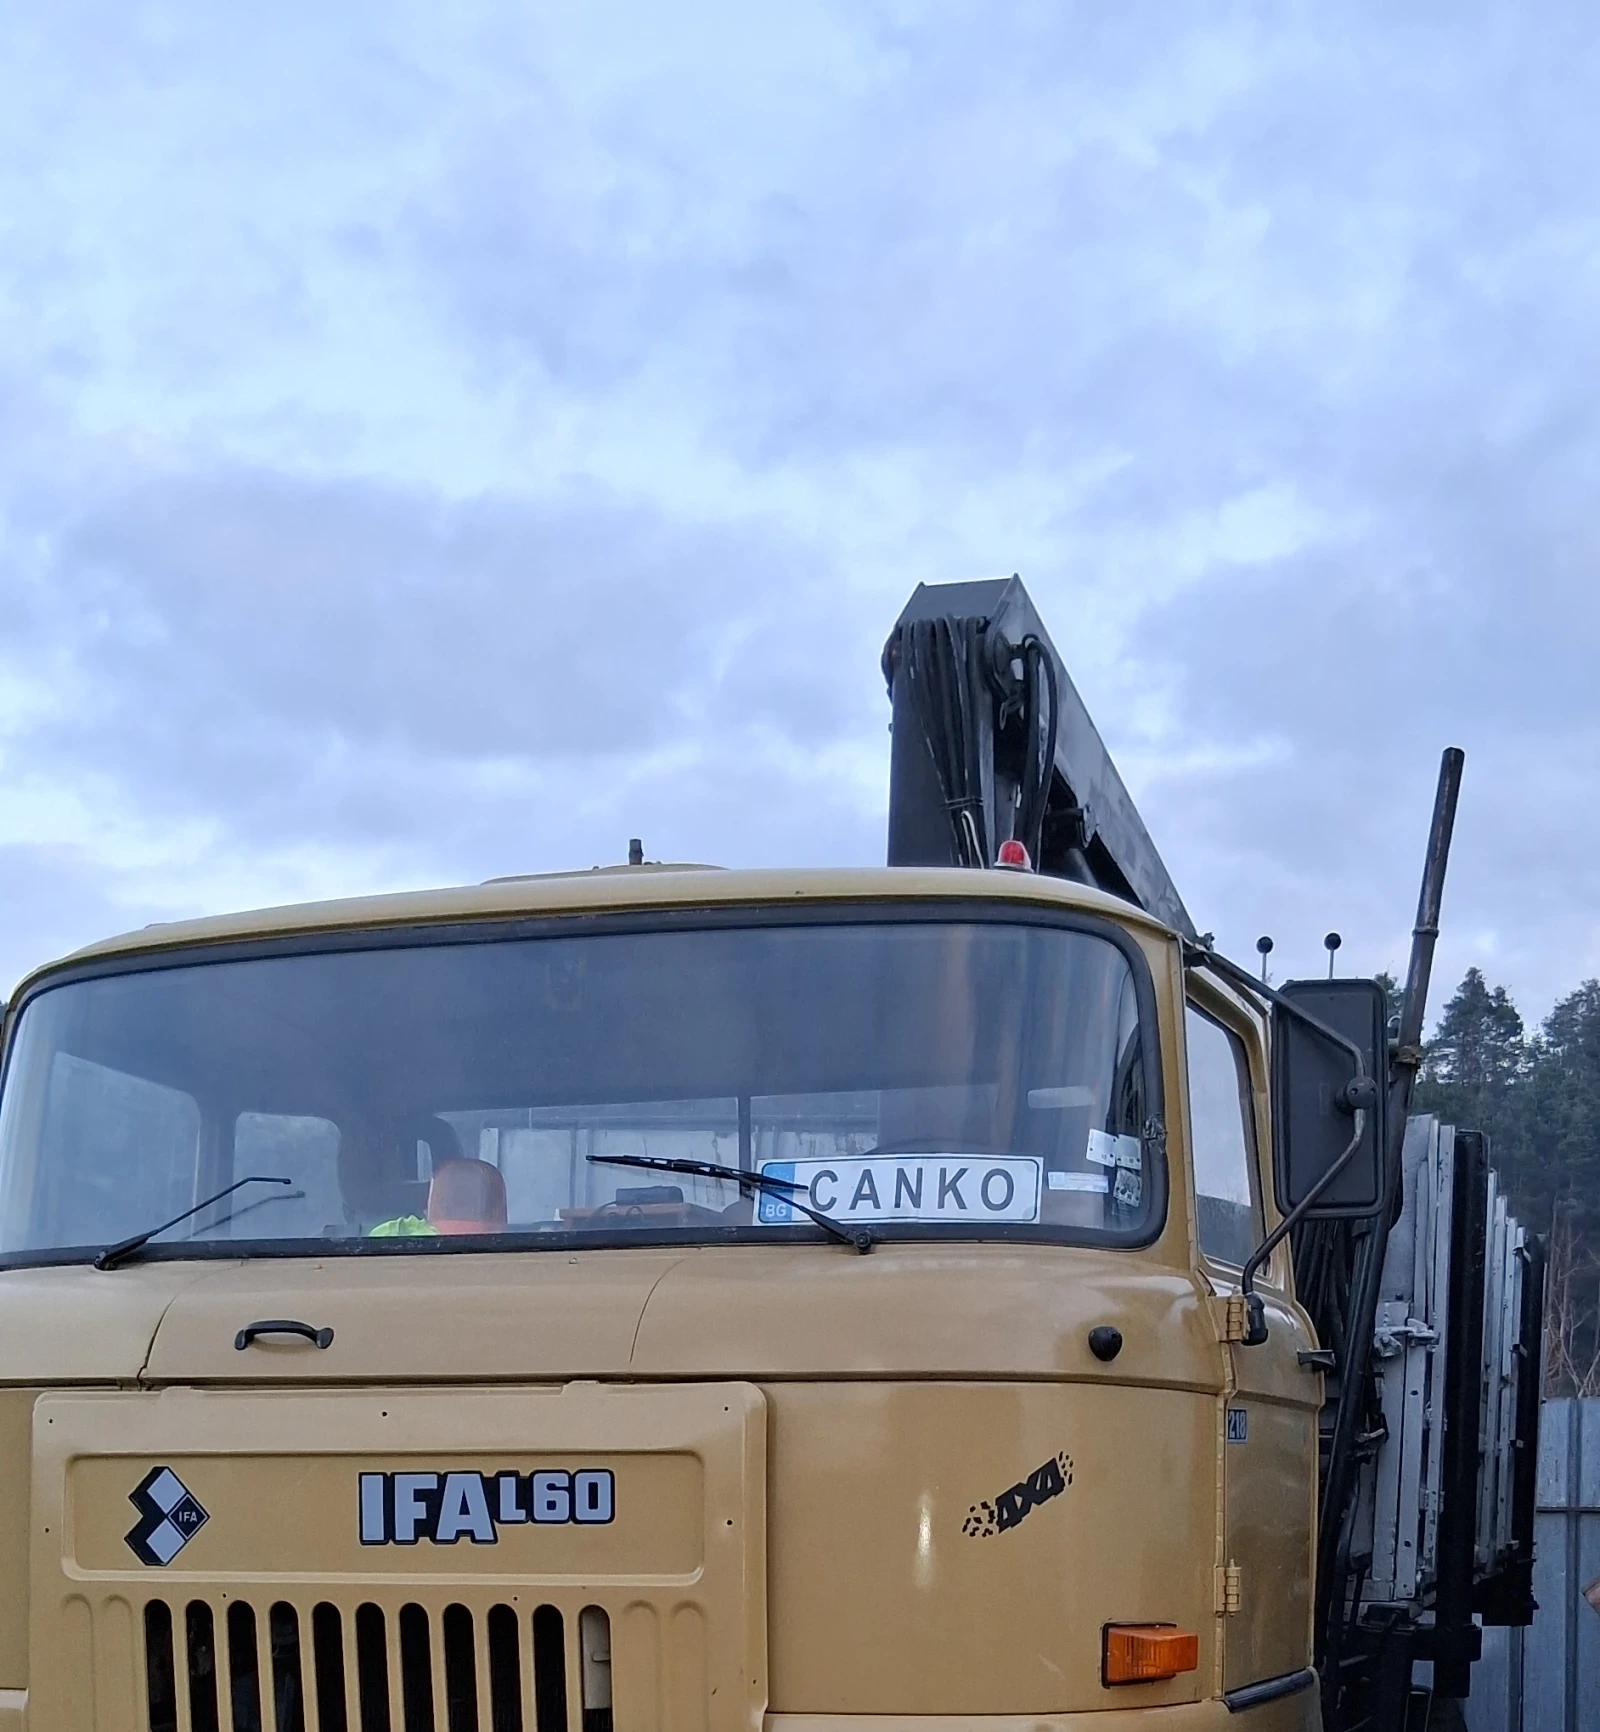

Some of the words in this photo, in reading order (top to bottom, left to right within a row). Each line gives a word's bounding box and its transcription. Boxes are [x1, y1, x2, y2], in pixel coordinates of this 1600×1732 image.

[809, 1166, 1015, 1212] CANKO
[765, 1202, 787, 1218] BG
[178, 1510, 198, 1523] IFA
[359, 1472, 498, 1544] IFA
[498, 1470, 614, 1524] L60
